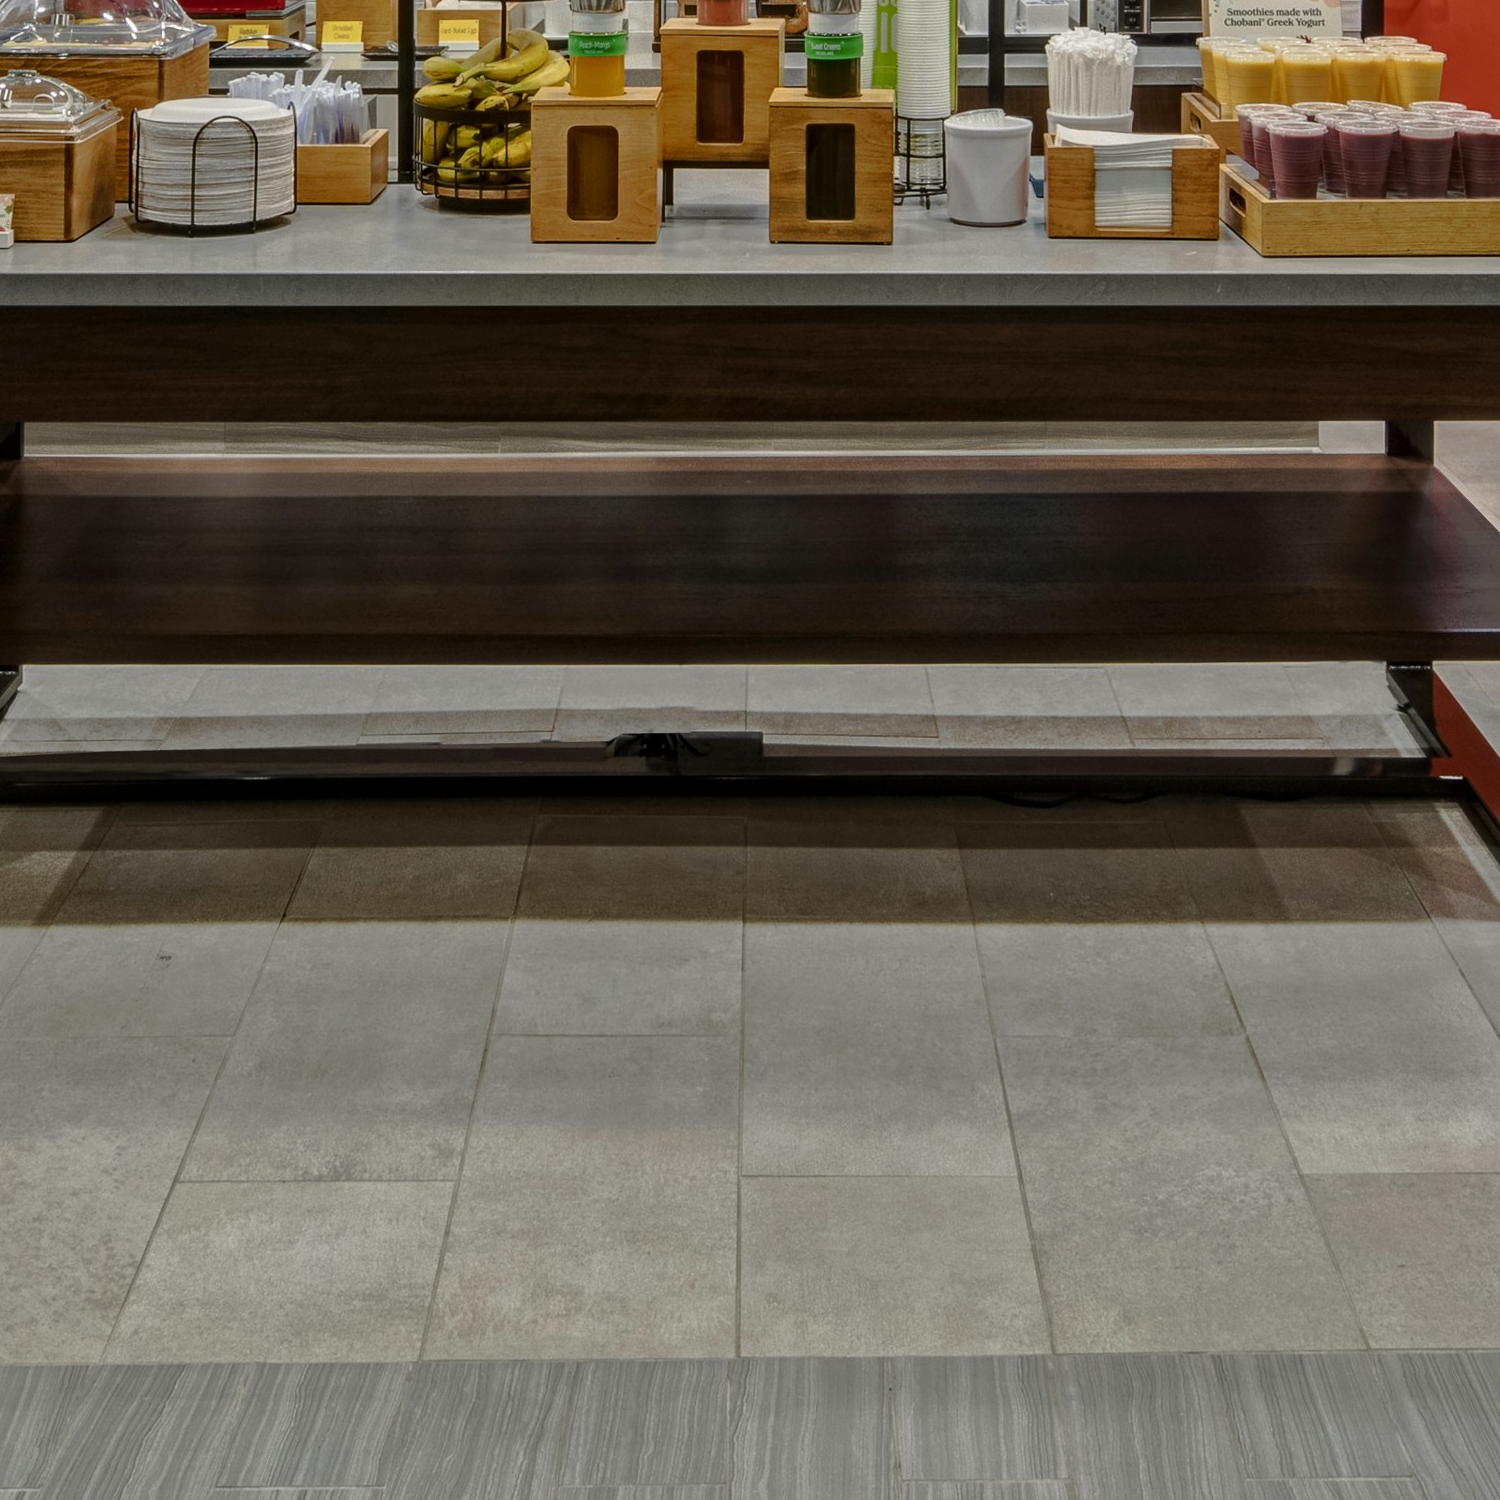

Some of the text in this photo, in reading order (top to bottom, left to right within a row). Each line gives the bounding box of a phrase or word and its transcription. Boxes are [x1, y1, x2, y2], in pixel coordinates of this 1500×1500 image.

[1227, 8, 1322, 16] Smoothies made with
[1266, 18, 1294, 27] Greek
[1296, 18, 1326, 28] Yogurt
